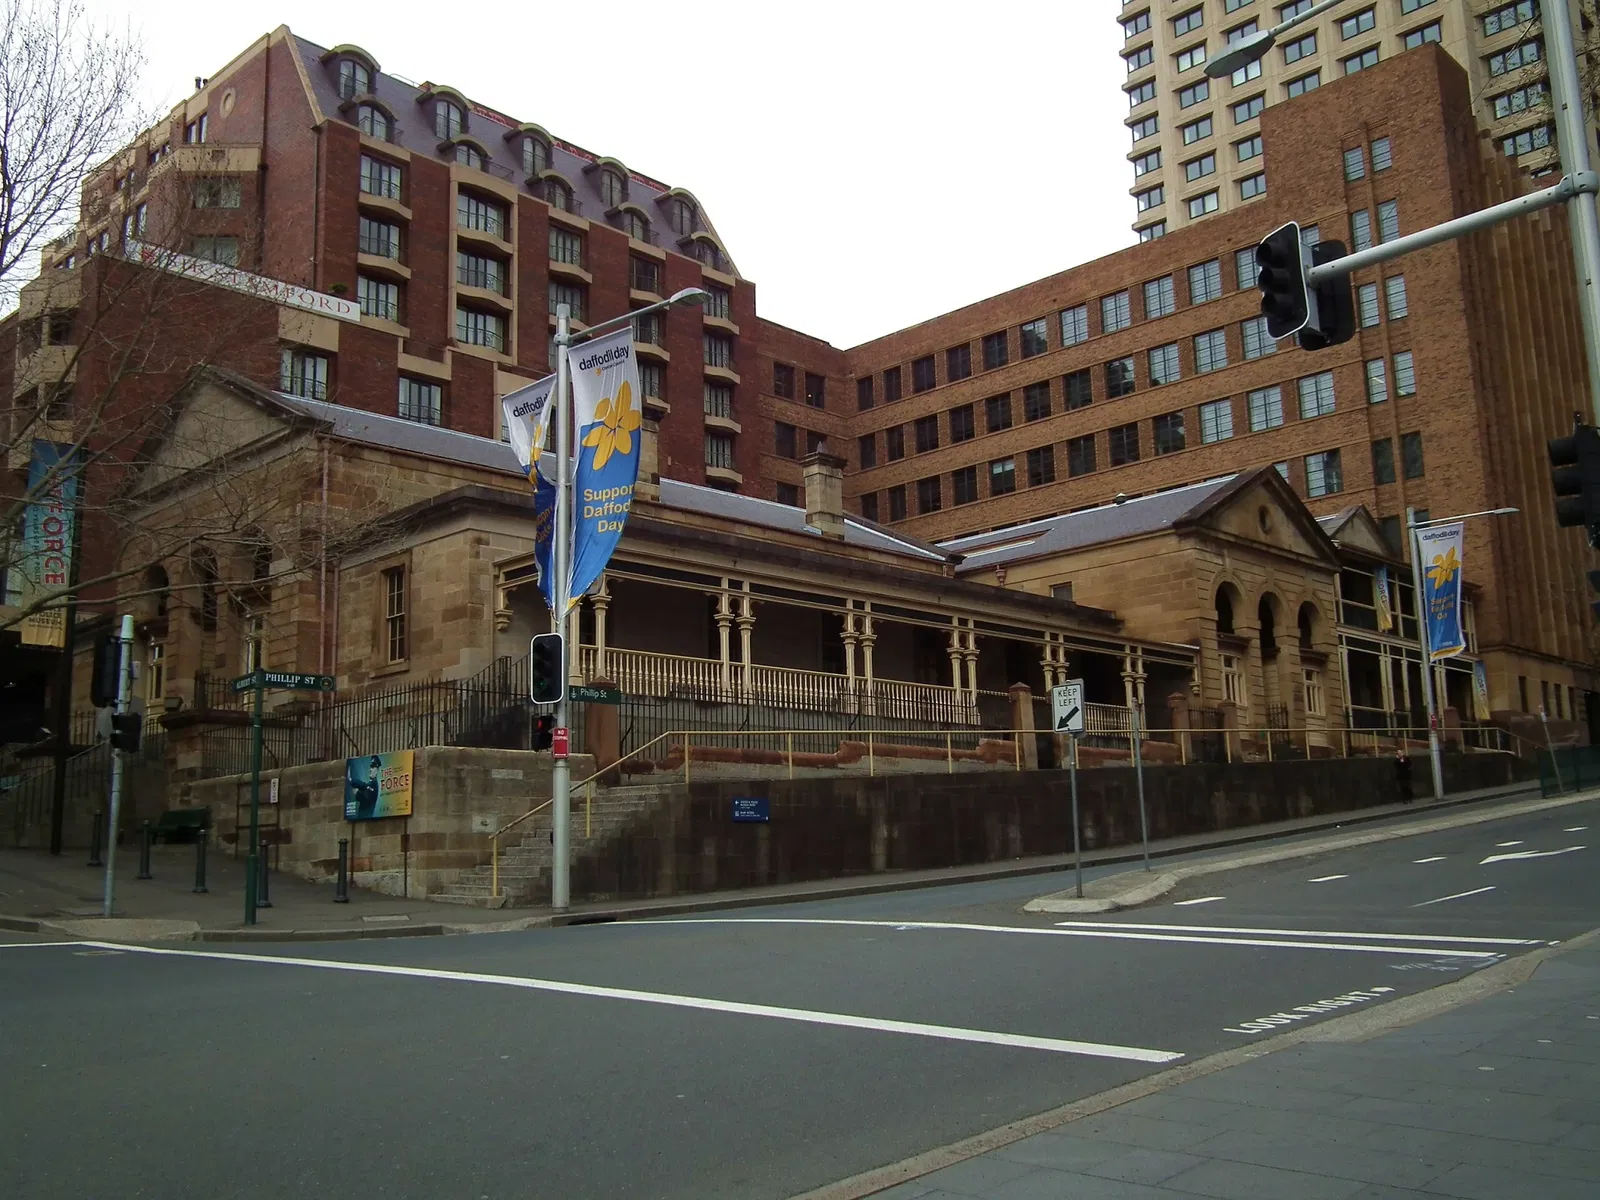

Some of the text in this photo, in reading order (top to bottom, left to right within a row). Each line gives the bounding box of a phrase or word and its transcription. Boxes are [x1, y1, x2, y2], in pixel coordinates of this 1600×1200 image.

[214, 267, 351, 315] STAMFORD
[598, 520, 625, 533] Day
[42, 503, 67, 585] FORCE
[265, 673, 316, 685] PHILLIP ST
[580, 688, 607, 699] Phillip St
[1058, 688, 1078, 697] KEEP
[1059, 698, 1077, 706] LEFT
[380, 766, 392, 777] THE
[381, 774, 409, 790] FORCE
[1222, 990, 1381, 1036] LOOK RIGHT
